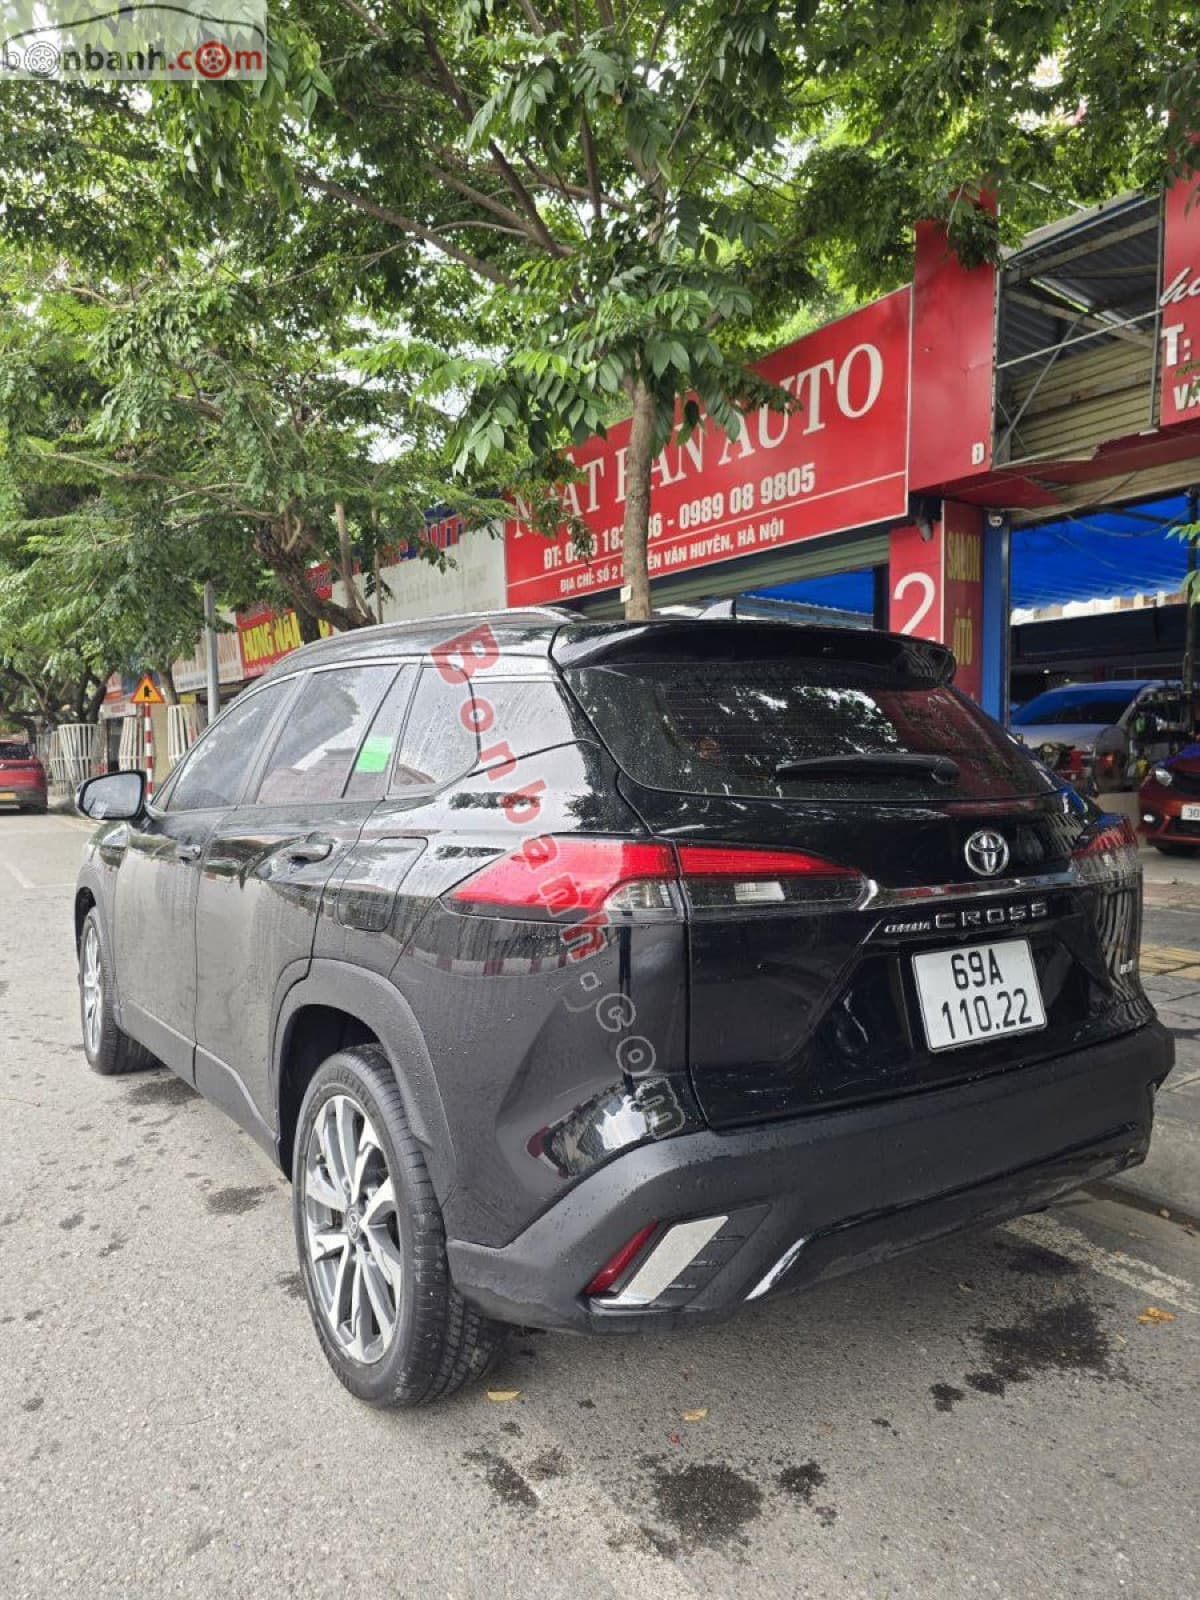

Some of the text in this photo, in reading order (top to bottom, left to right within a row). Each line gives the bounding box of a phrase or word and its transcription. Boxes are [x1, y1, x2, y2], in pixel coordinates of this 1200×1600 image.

[718, 343, 883, 465] AUTO
[678, 492, 724, 530] 0989
[729, 482, 754, 515] 08
[760, 462, 816, 505] 9805
[611, 565, 619, 579] 2
[737, 523, 756, 547] HÀ
[759, 516, 784, 542] NỘI
[893, 571, 936, 641] 2
[935, 902, 1048, 929] CROSS
[951, 948, 1004, 991] 69A
[942, 987, 1033, 1041] 110.22
